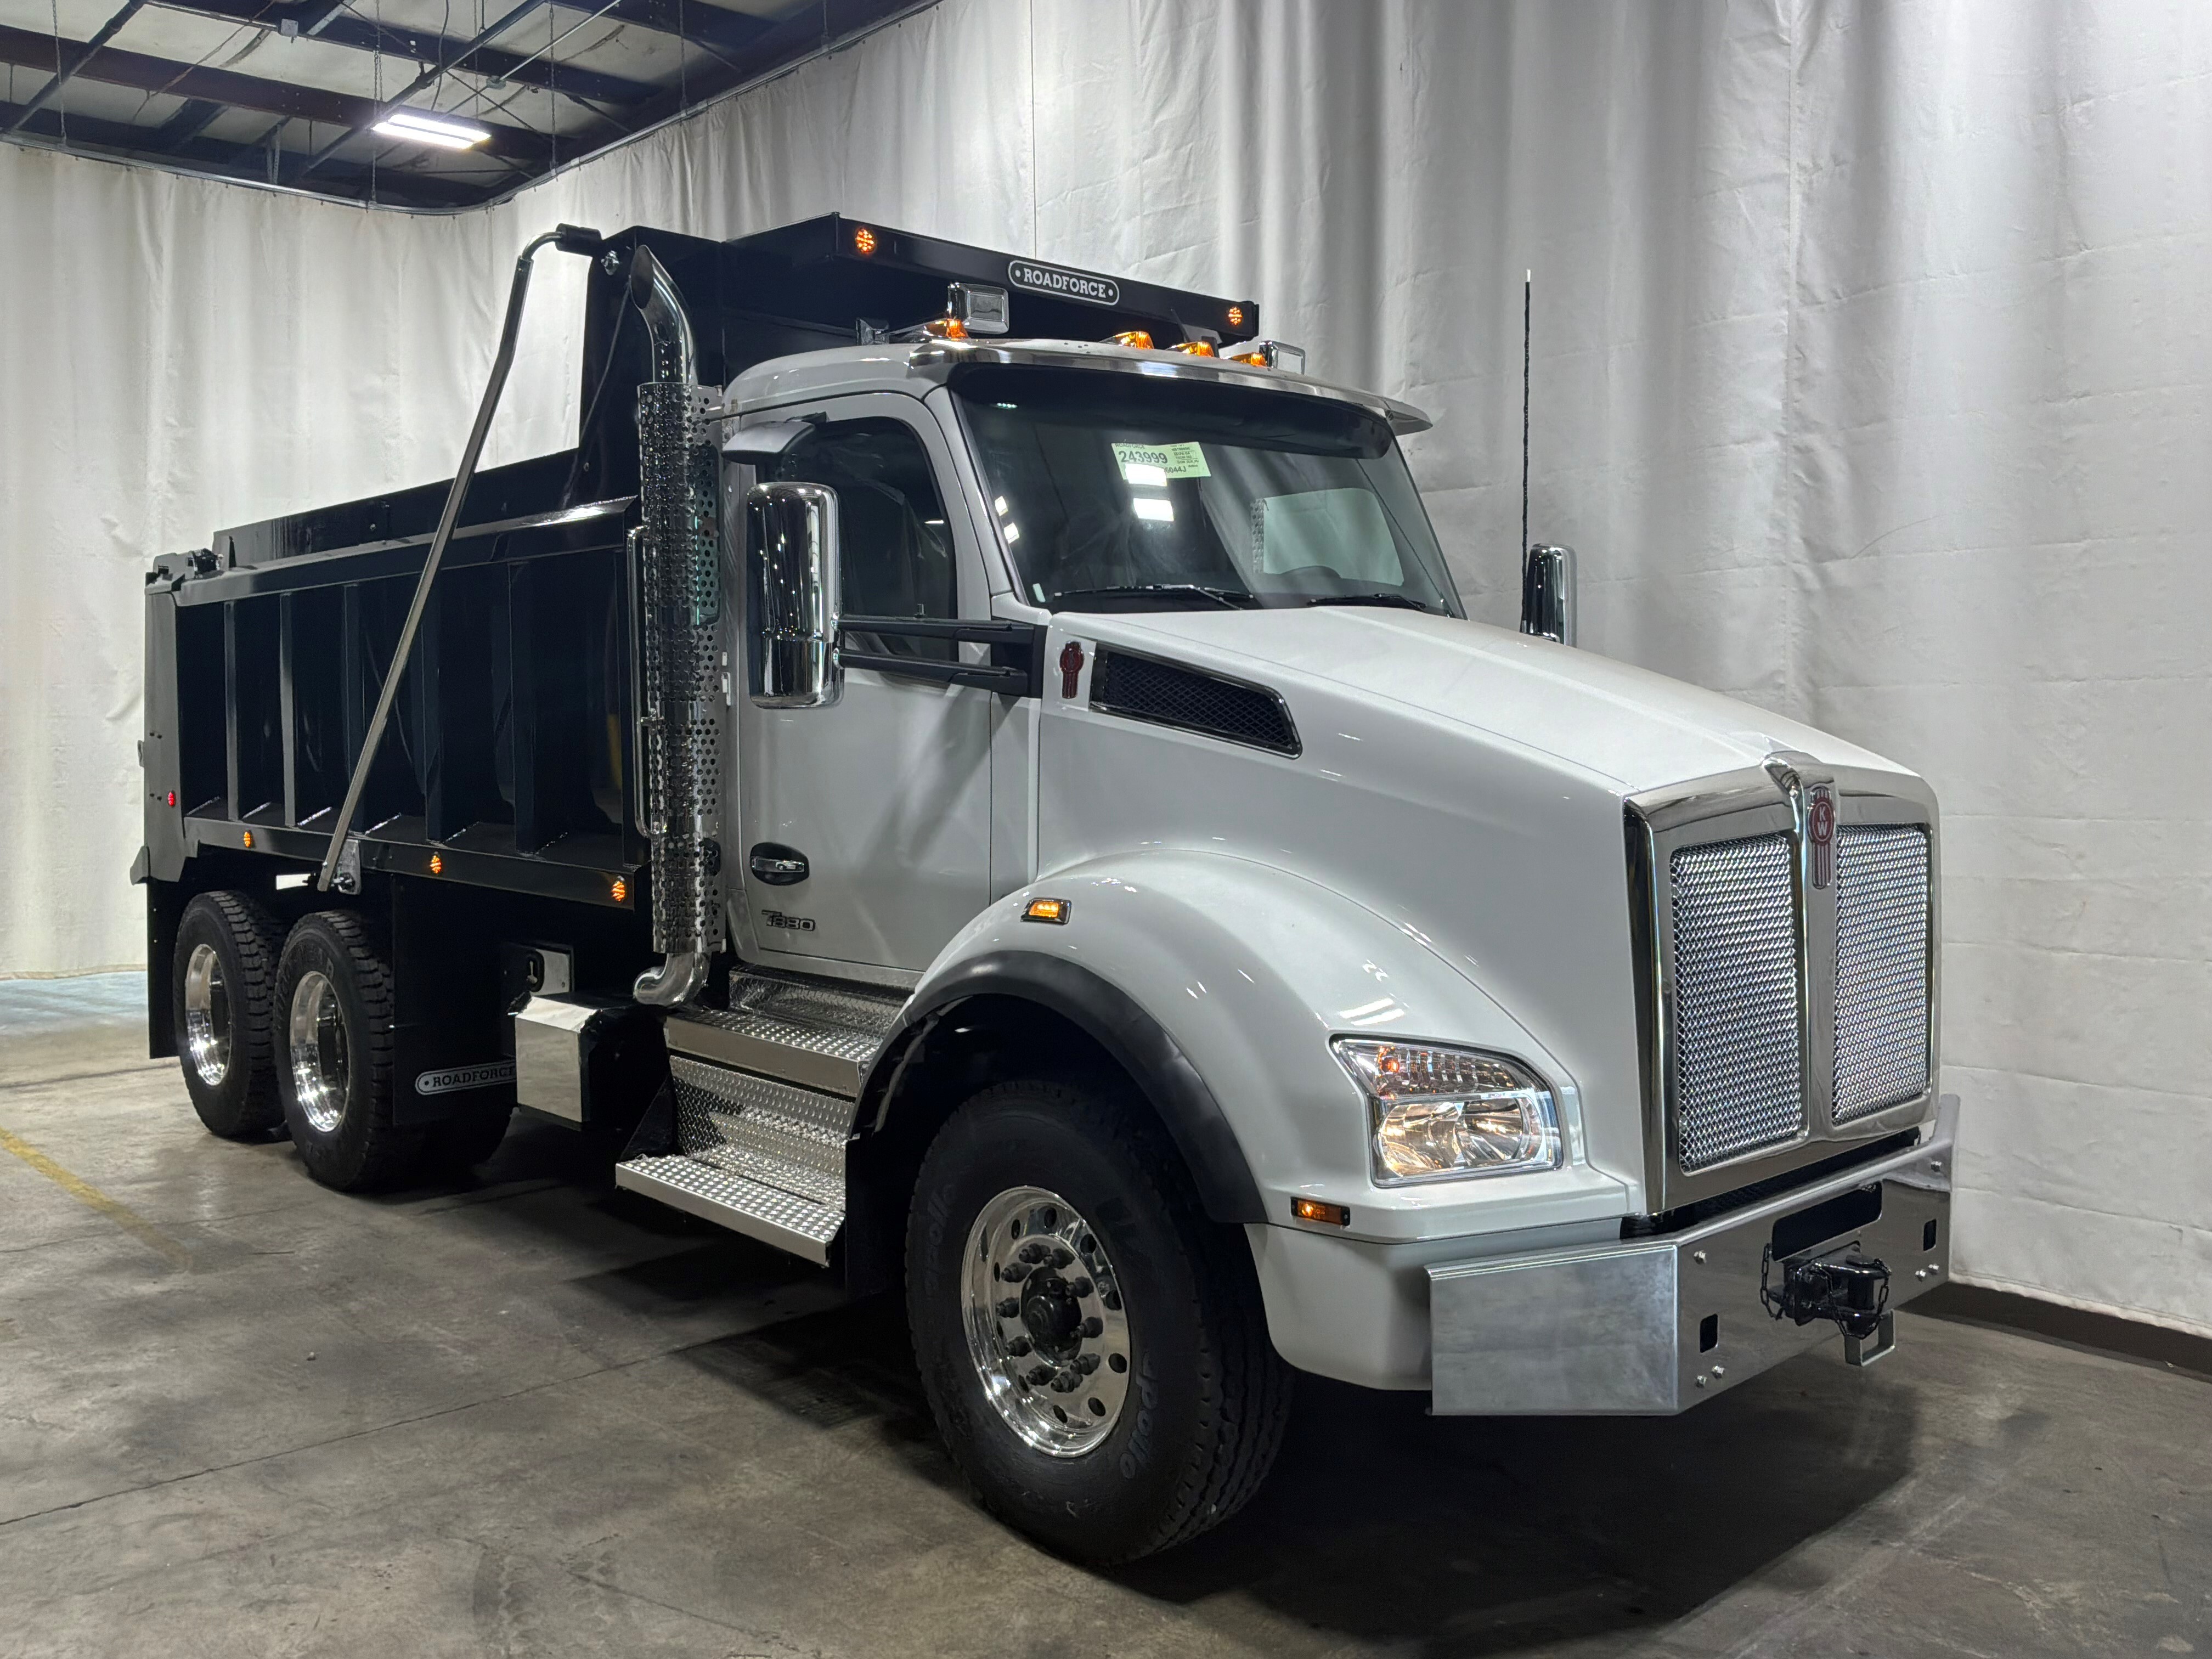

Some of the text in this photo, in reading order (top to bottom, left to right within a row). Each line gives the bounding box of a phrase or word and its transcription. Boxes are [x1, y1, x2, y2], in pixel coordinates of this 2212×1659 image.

[1024, 268, 1107, 298] ROADFORCE
[1119, 450, 1168, 464] 243999
[761, 909, 816, 932] T880
